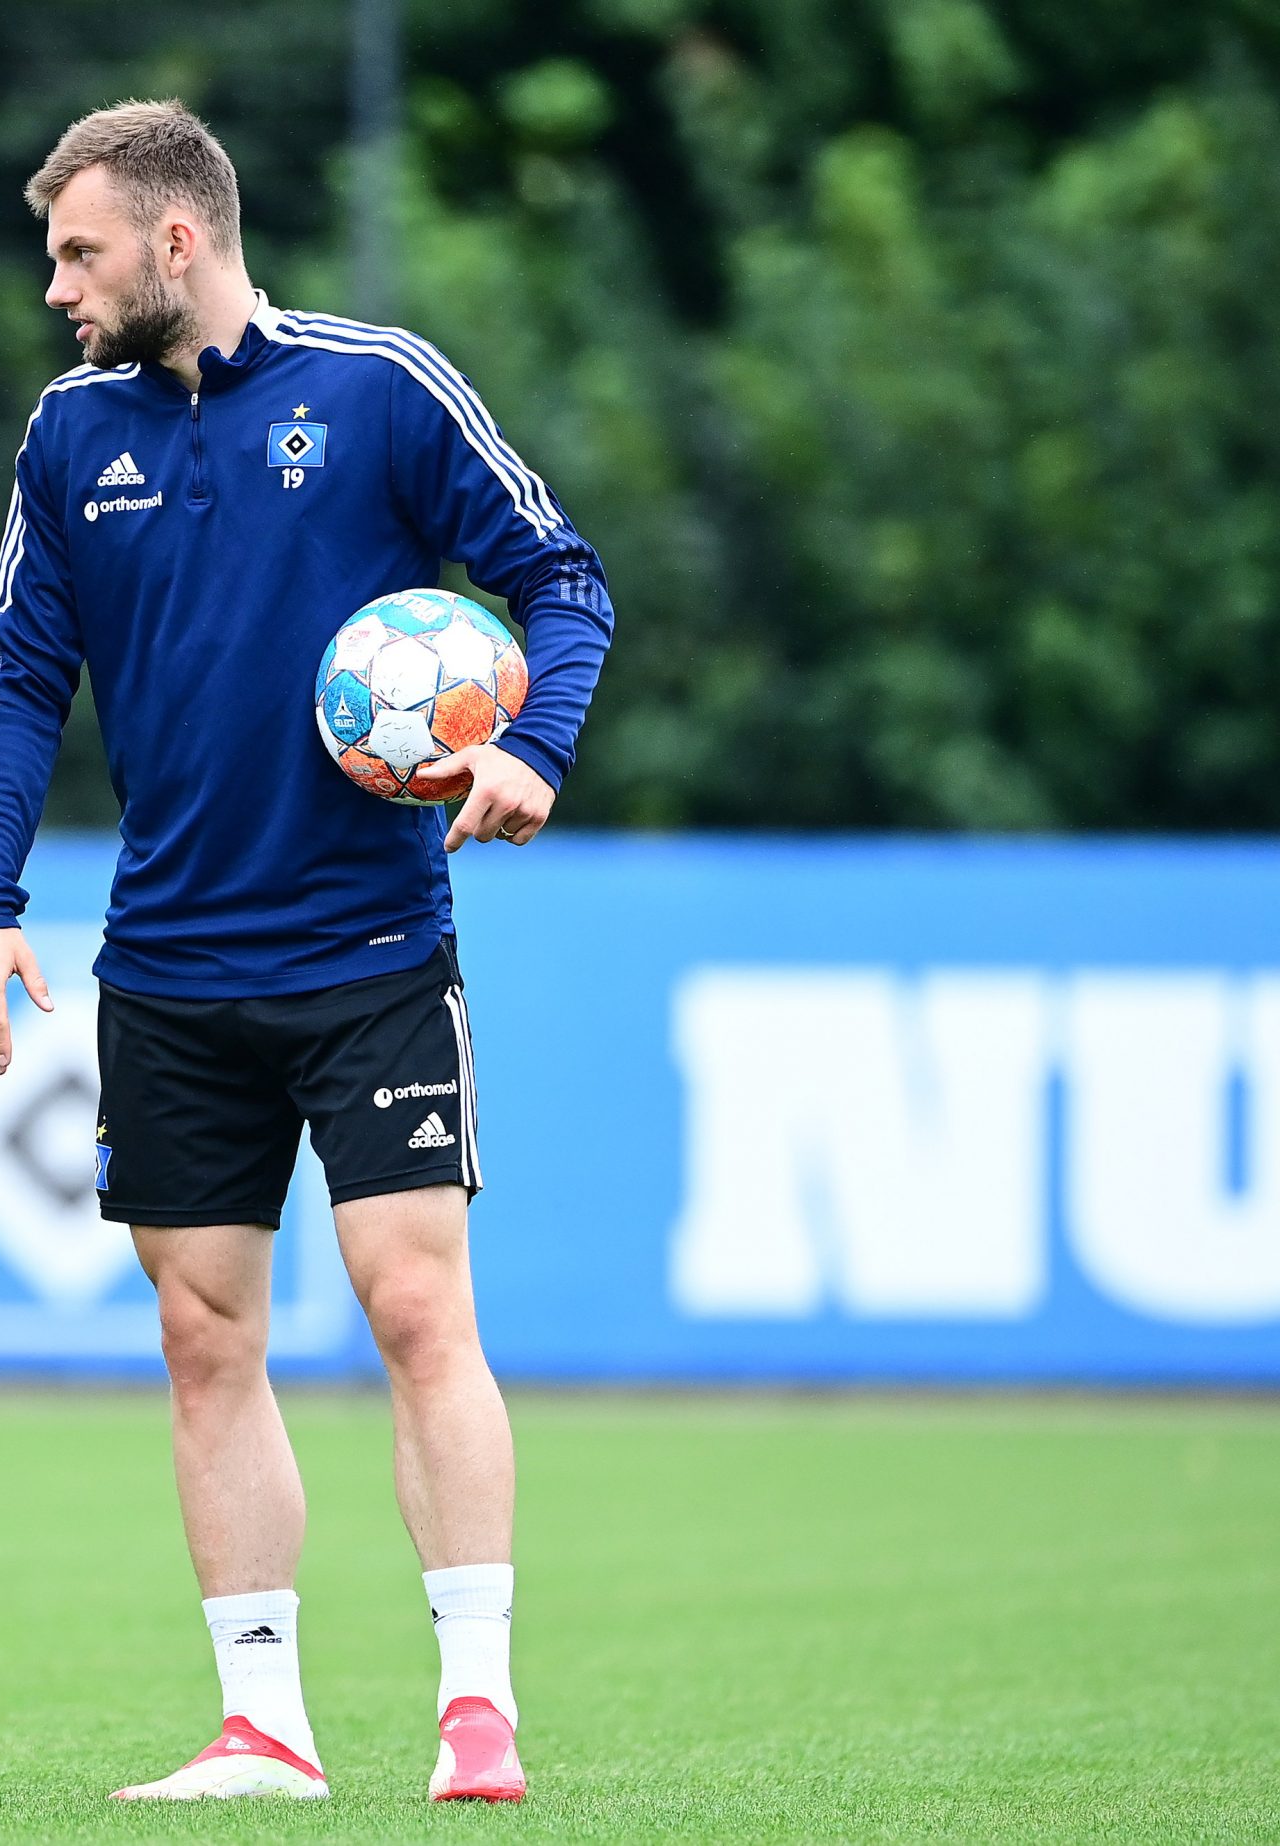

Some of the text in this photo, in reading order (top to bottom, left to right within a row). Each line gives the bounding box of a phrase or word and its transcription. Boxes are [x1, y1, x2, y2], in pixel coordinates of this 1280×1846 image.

[97, 472, 145, 487] adidas
[281, 468, 305, 488] 19
[100, 491, 162, 512] orthomol
[394, 1079, 458, 1099] orthomol
[408, 1133, 455, 1149] adidas
[234, 1634, 282, 1644] adidas
